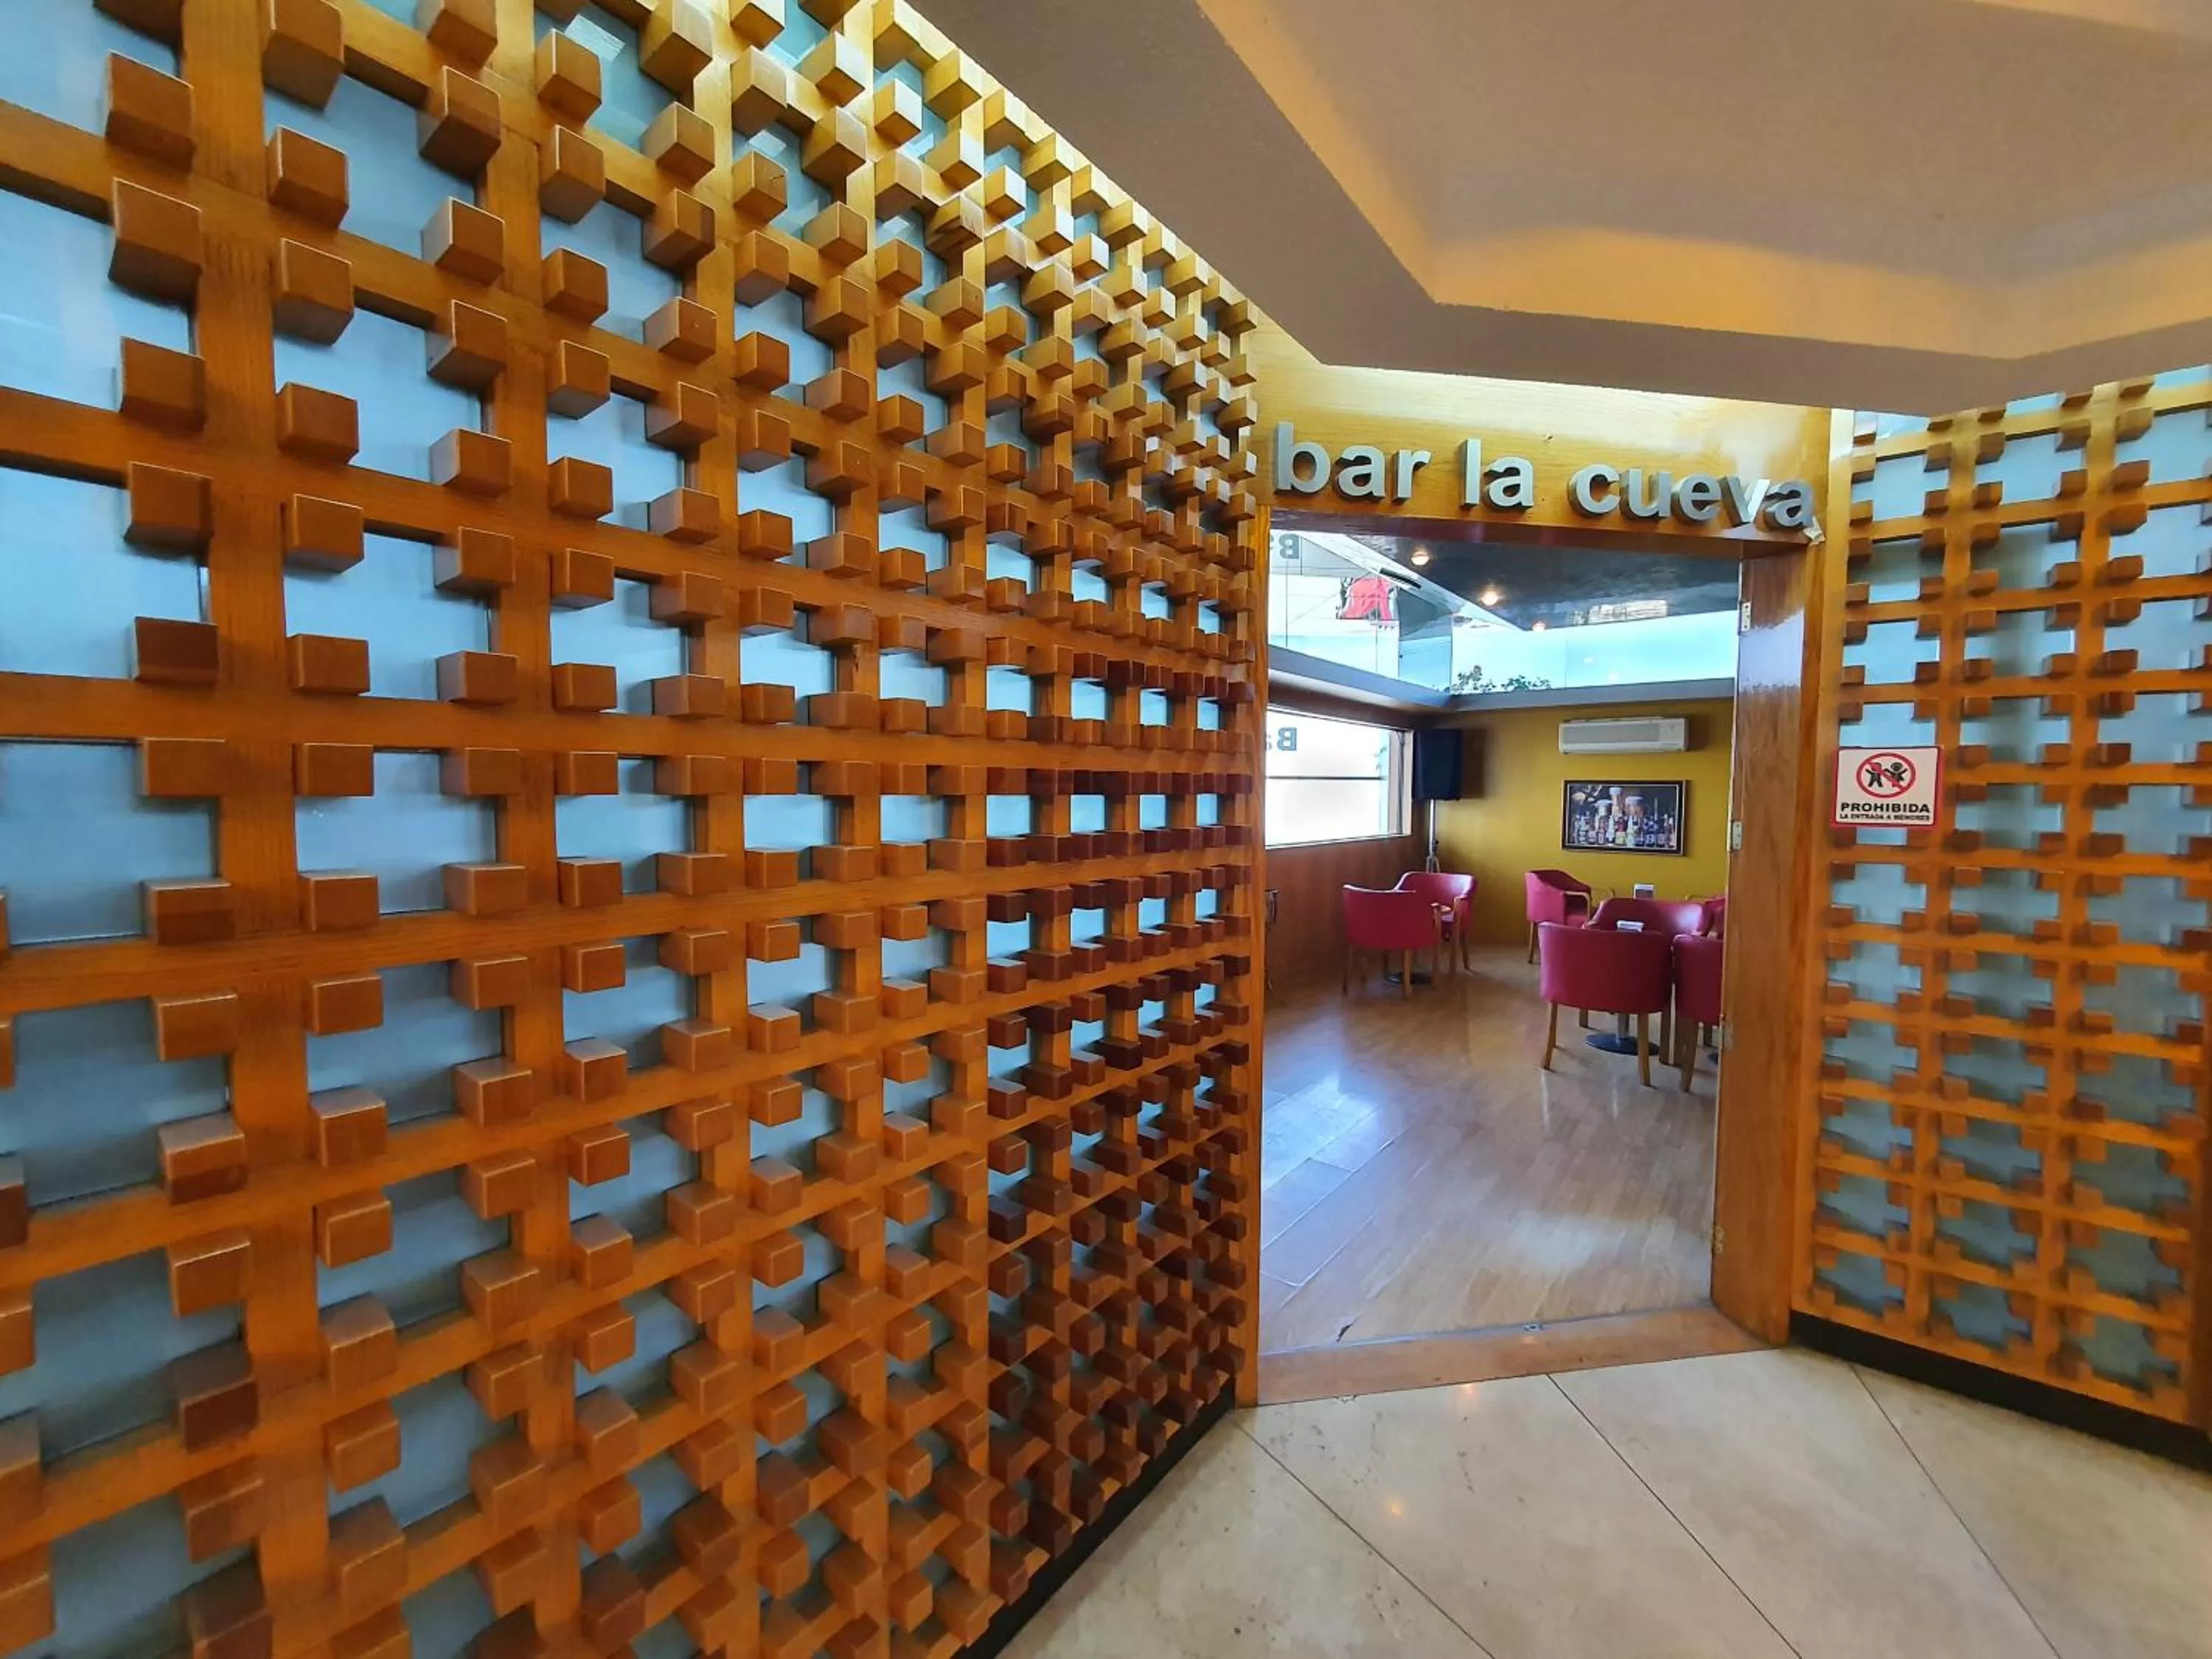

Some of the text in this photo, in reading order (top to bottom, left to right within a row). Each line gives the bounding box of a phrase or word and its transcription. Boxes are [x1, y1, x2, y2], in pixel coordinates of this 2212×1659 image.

[1274, 420, 1815, 529] bar la cueva
[1840, 802, 1930, 813] PROHIBIDA
